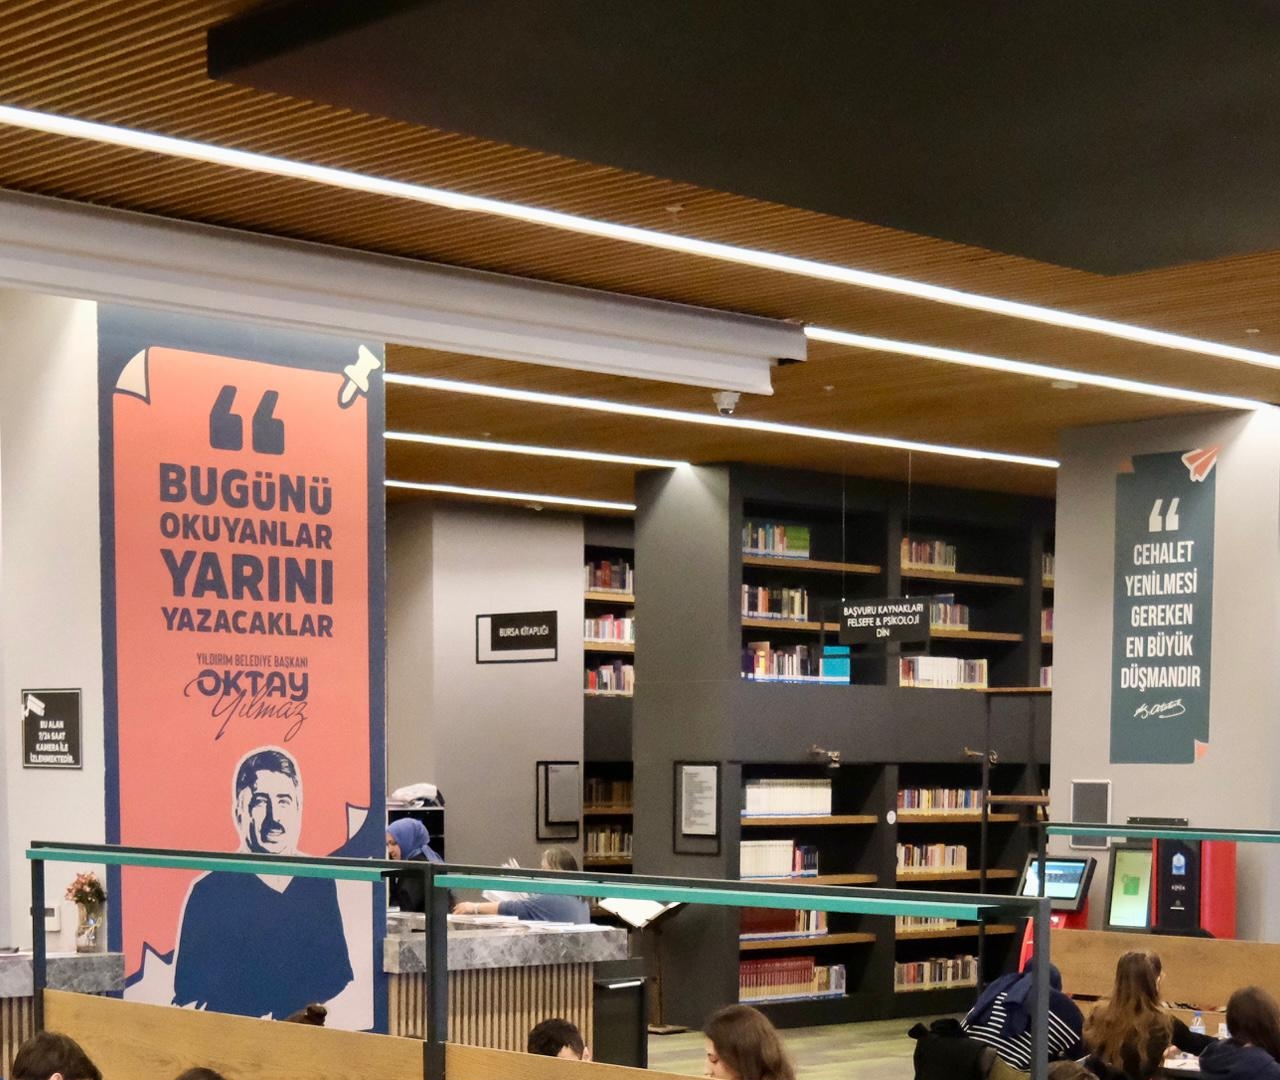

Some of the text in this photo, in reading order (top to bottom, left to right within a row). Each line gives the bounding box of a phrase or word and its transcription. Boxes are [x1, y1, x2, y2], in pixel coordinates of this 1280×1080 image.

[159, 462, 333, 516] BUGÜNÜ
[159, 511, 333, 550] OKUYANLAR
[1133, 540, 1195, 566] CEHALET
[160, 548, 334, 605] YARINI
[1124, 567, 1198, 597] YENİLMESİ
[161, 606, 334, 638] YAZACAKLAR
[843, 603, 924, 617] BAŞVURU KAYNAKLARI
[847, 614, 920, 627] FELSEFE & PSİKOLOJİ
[1131, 603, 1193, 628] GEREKEN
[499, 627, 519, 637] BURSA
[876, 627, 890, 638] DİN
[1126, 631, 1194, 658] EN BÜYÜK
[196, 653, 233, 666] YILDIRIM
[197, 669, 309, 701] OKTAY
[1120, 663, 1201, 692] DÜŞMANDIR
[48, 720, 65, 728] ALAN
